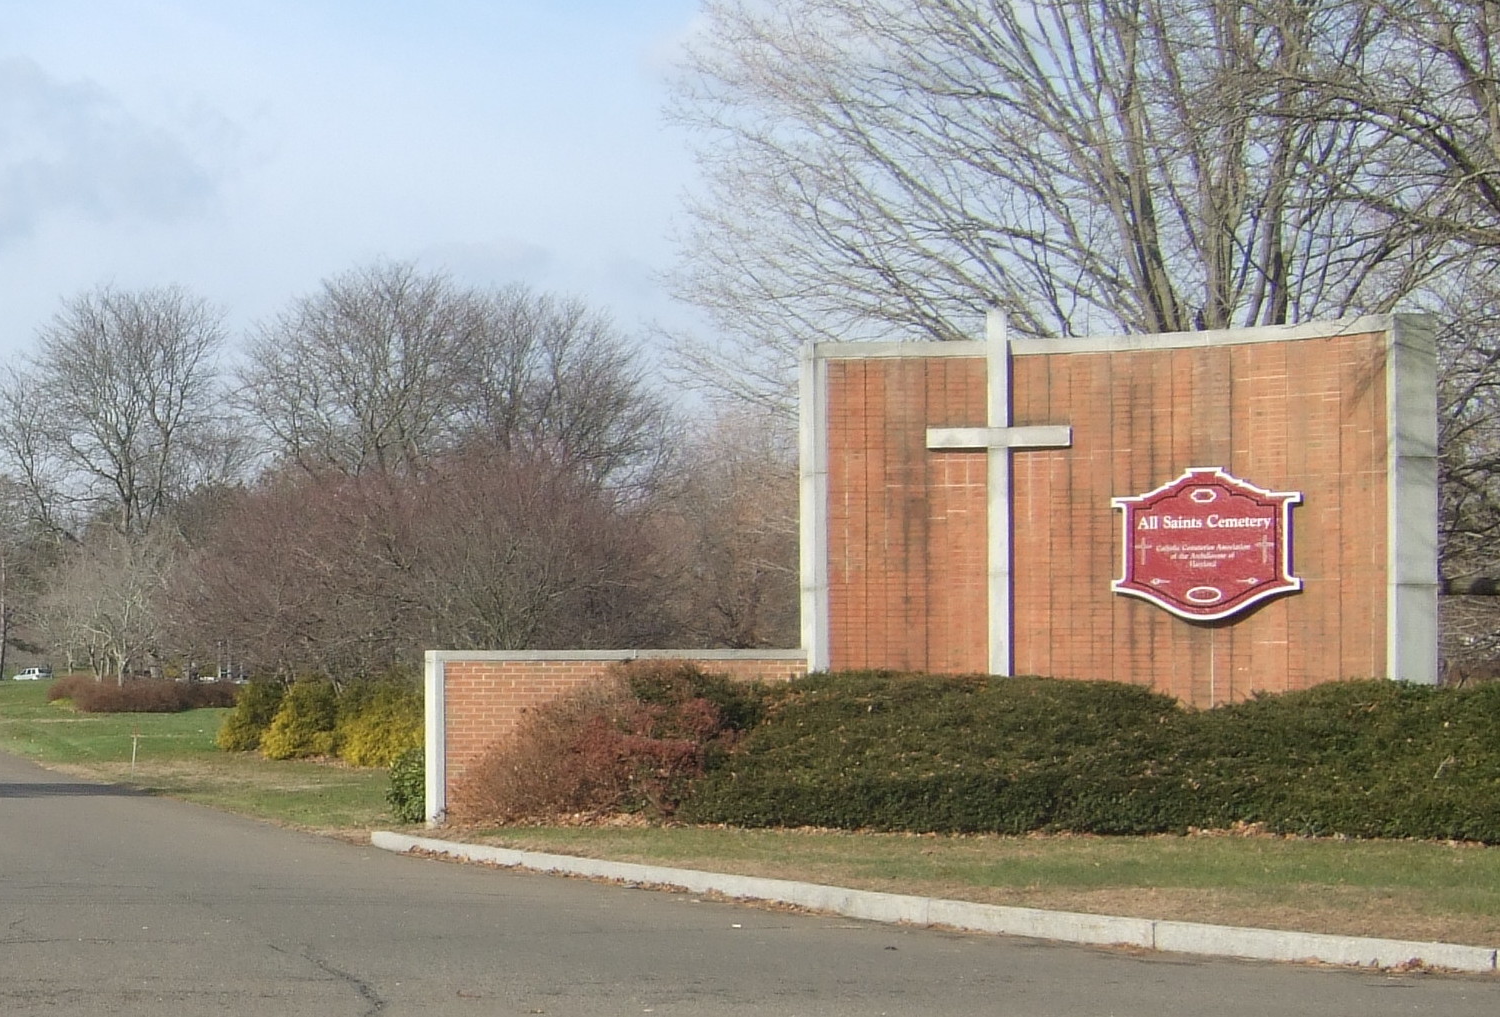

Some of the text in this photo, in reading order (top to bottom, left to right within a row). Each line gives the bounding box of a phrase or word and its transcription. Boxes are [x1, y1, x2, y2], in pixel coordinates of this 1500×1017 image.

[1137, 514, 1272, 530] All Saints Cemetery
